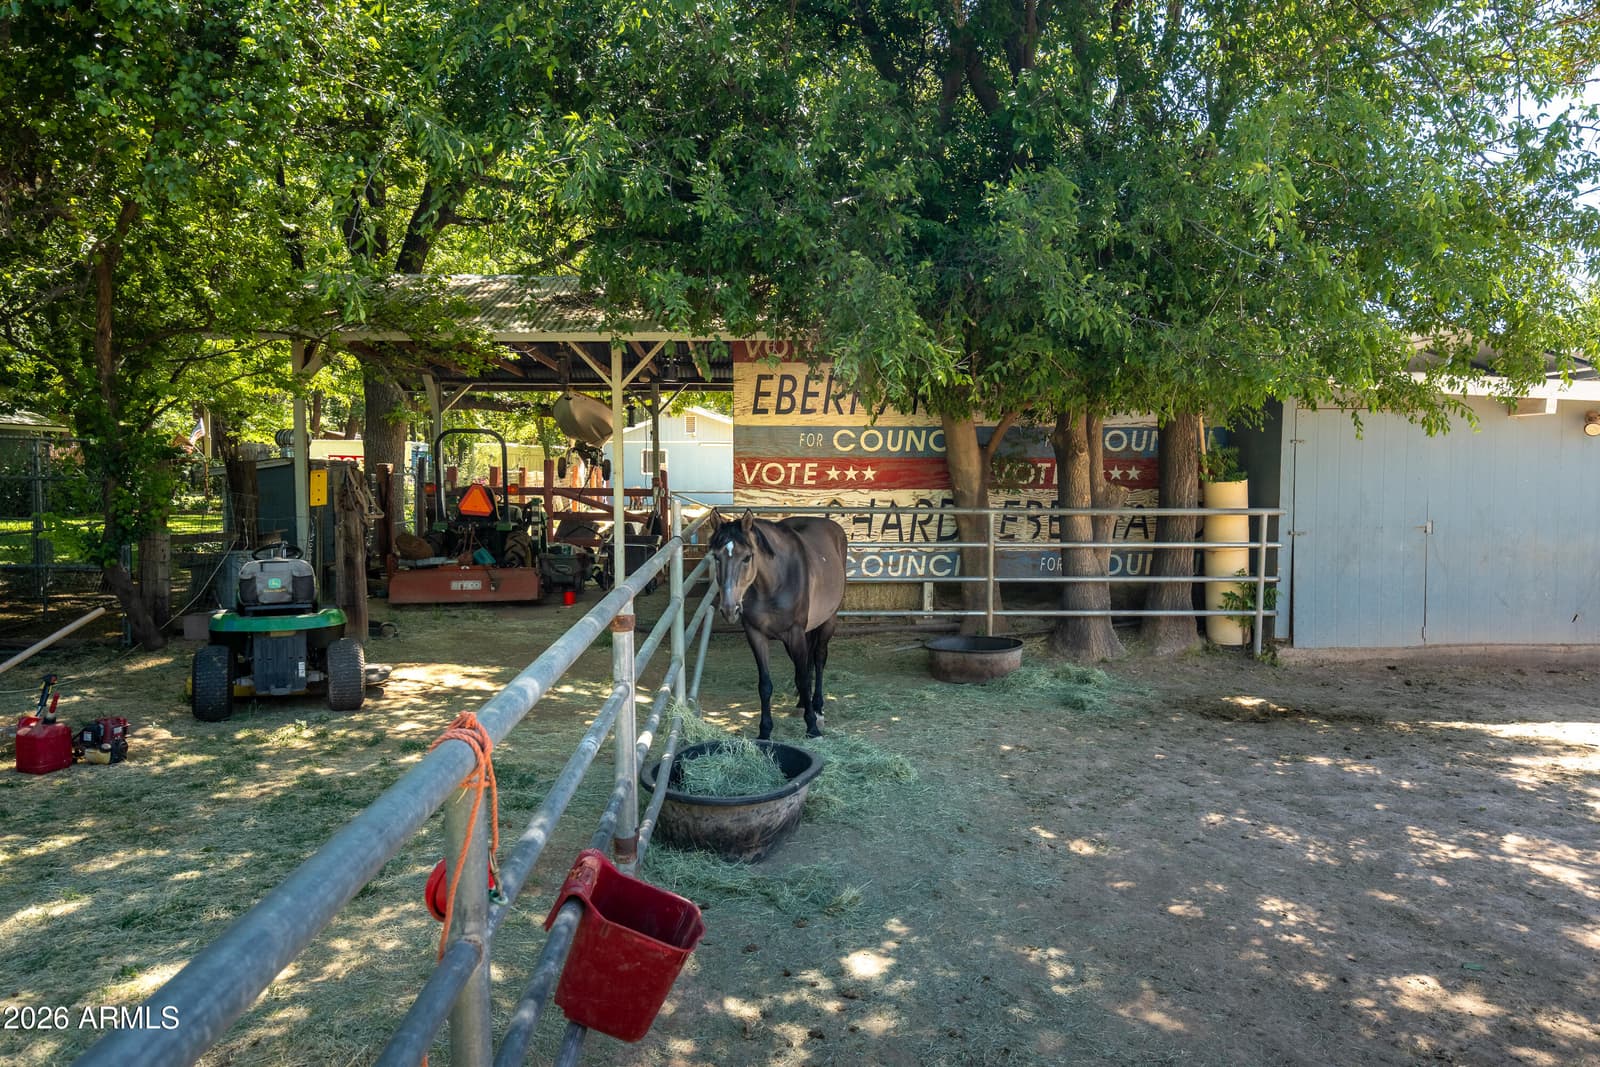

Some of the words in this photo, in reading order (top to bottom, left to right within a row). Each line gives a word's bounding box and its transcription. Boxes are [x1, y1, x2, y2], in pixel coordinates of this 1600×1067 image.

[798, 432, 824, 448] FOR
[832, 429, 946, 453] COUNC
[740, 462, 819, 485] VOTE
